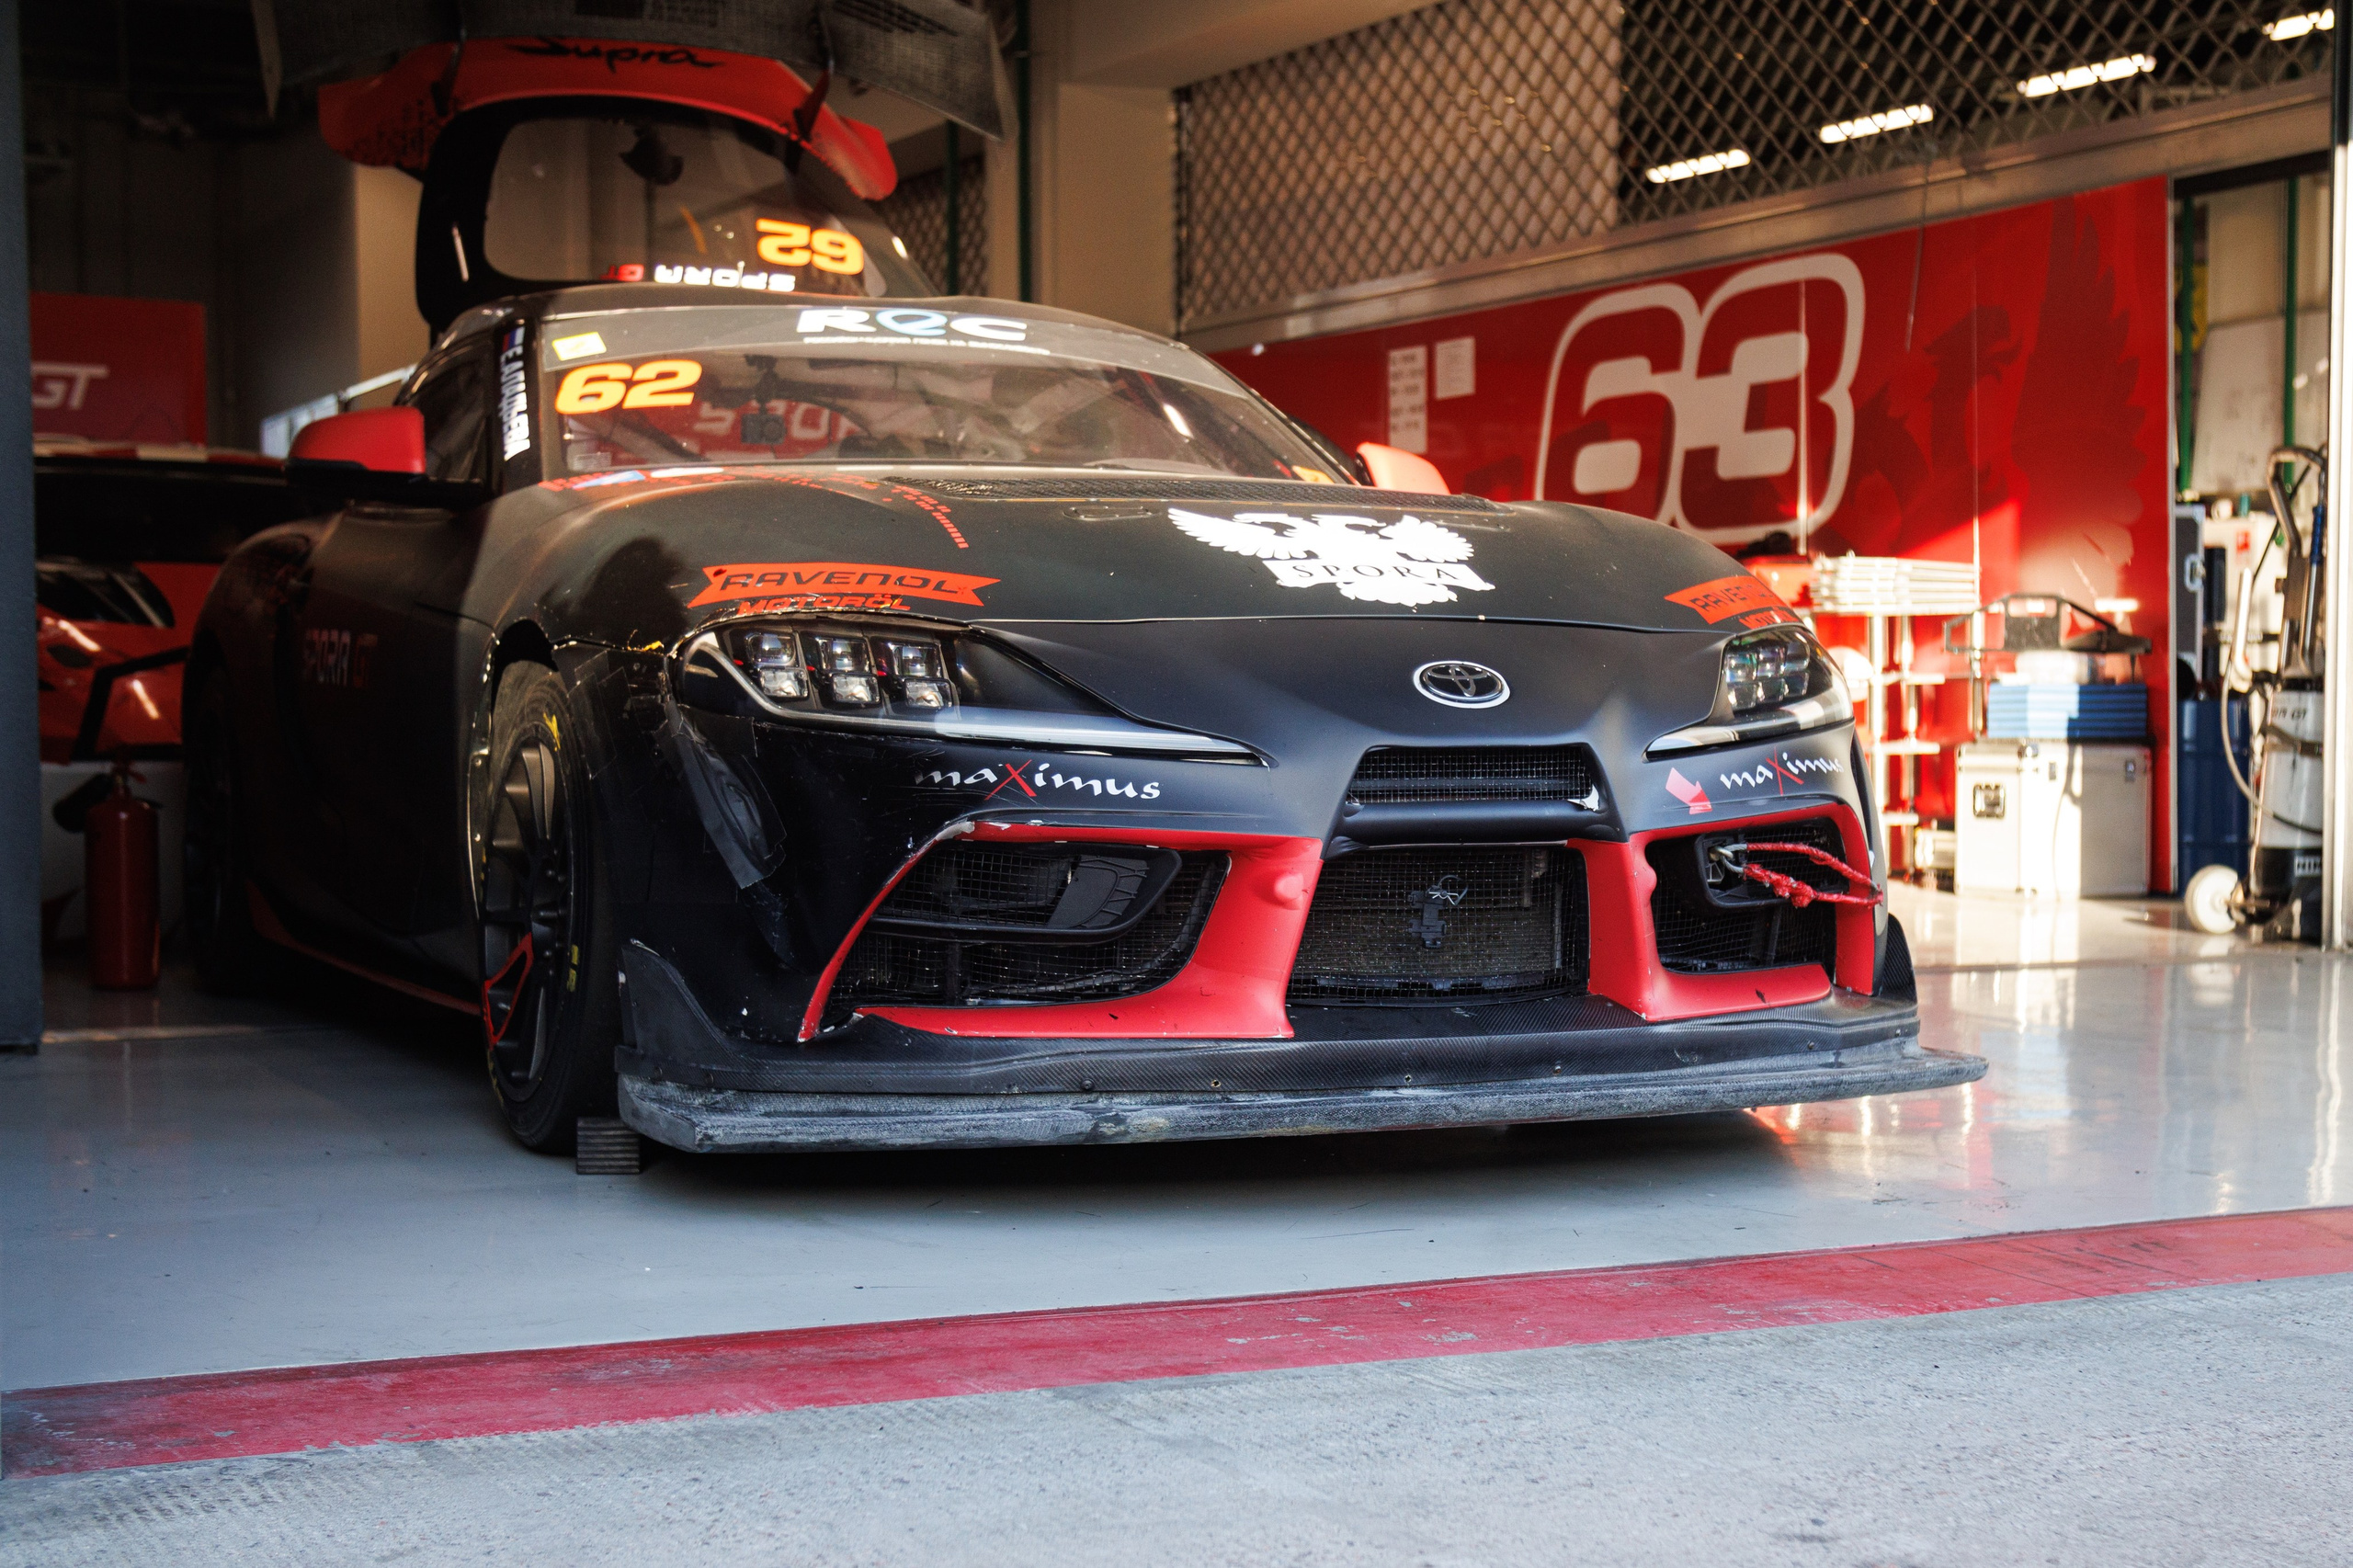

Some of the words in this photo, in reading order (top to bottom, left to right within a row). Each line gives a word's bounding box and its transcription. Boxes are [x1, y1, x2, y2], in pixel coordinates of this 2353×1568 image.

[506, 35, 725, 74] Supra
[756, 218, 864, 276] 62
[601, 264, 644, 281] GT
[654, 265, 796, 292] SPORA
[31, 361, 110, 410] GT
[554, 359, 703, 415] 62
[1534, 253, 1866, 546] 63
[720, 570, 961, 595] RAVENOL
[1292, 563, 1459, 580] SPORA
[737, 593, 911, 616] MOTORÖL
